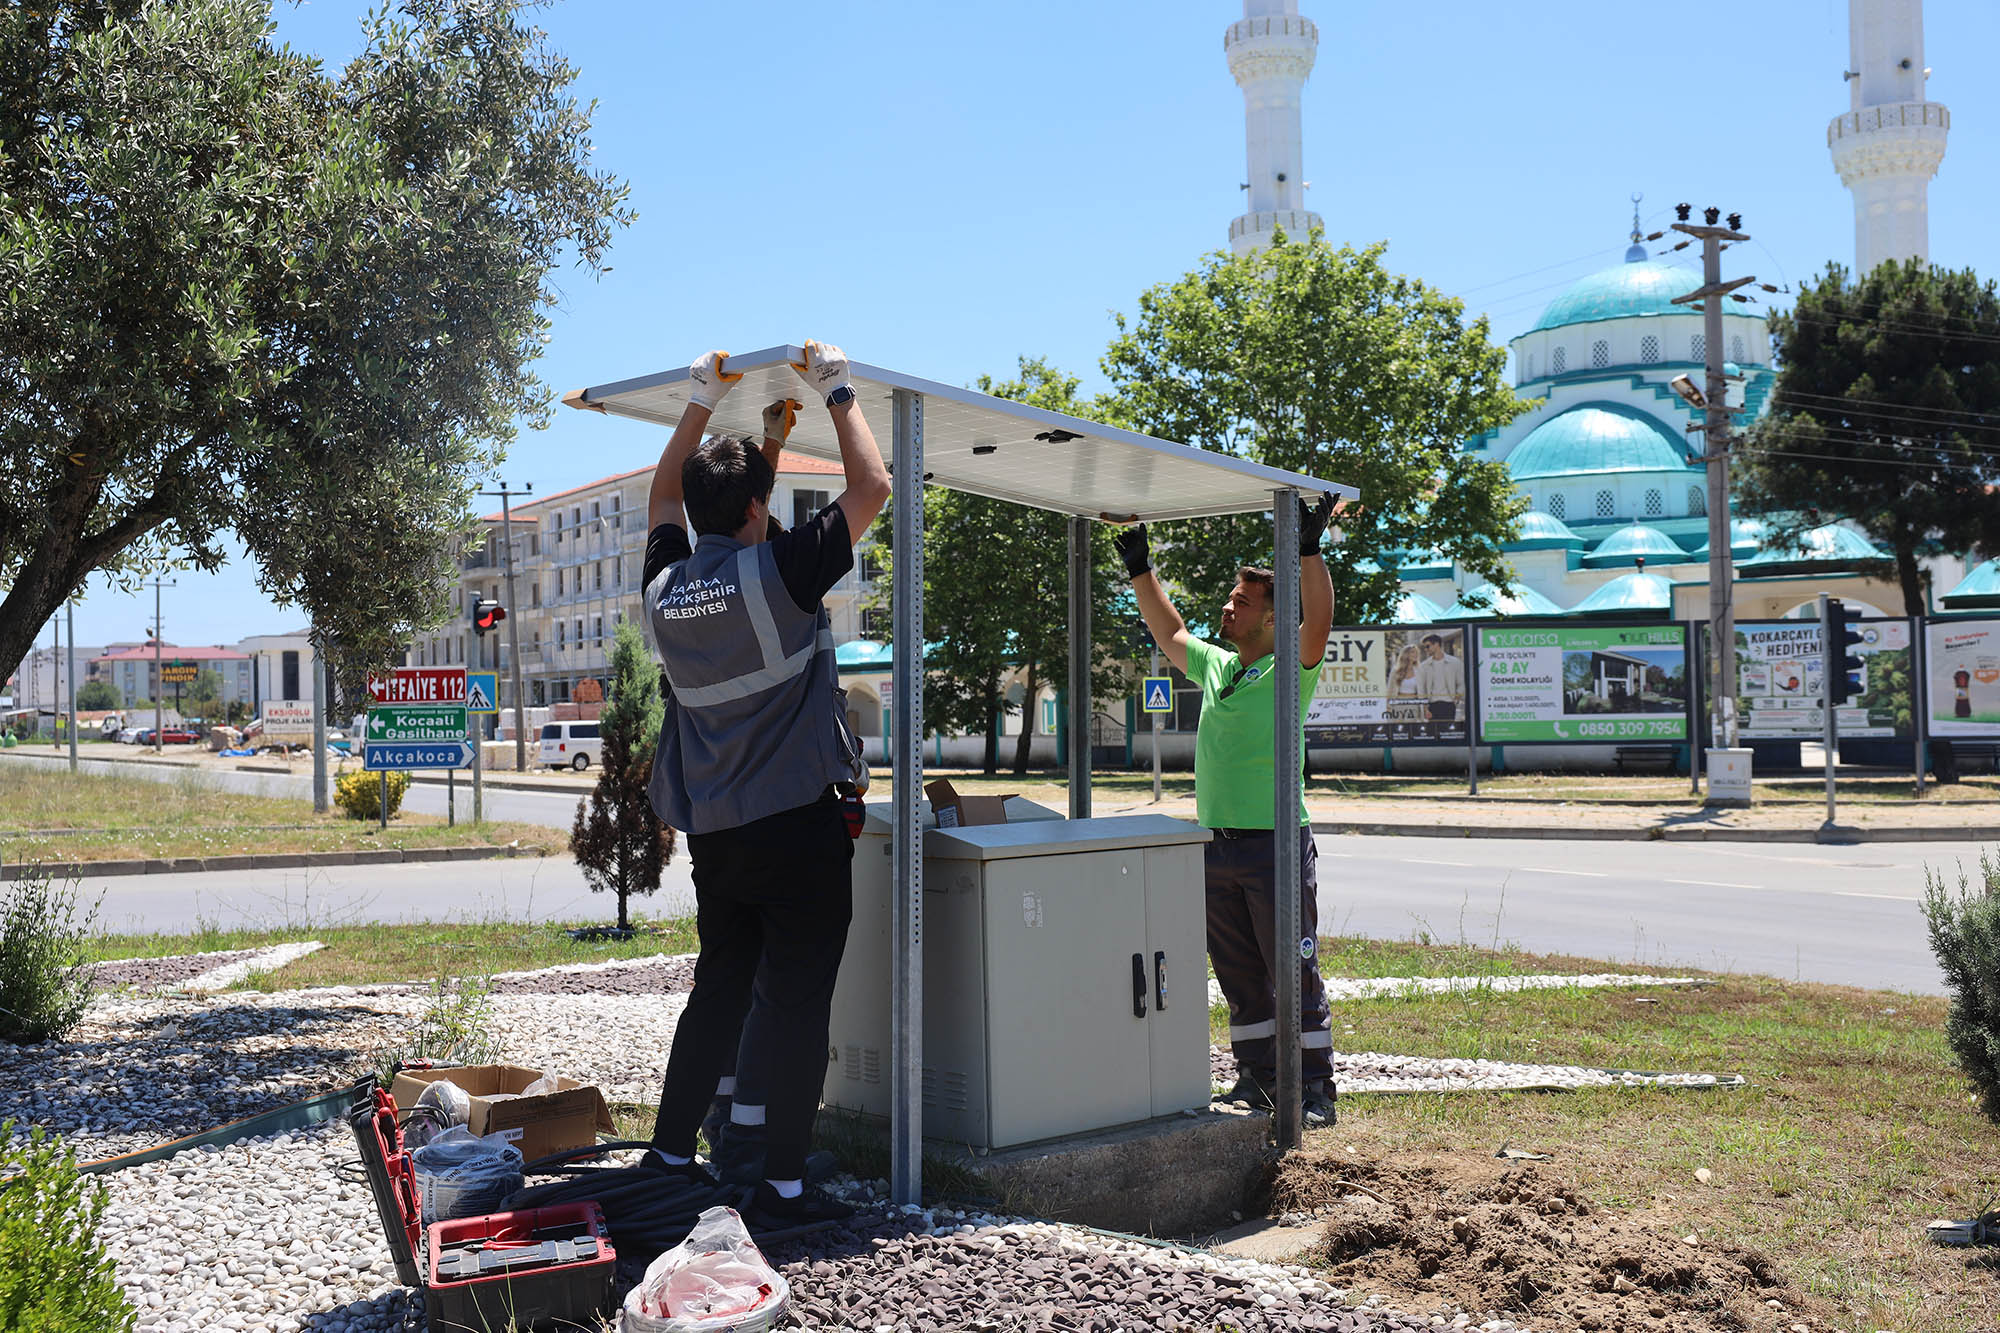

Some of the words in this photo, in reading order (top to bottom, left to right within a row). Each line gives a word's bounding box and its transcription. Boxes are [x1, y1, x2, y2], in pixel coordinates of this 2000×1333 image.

[663, 598, 728, 619] BELEDİYESİ
[1751, 629, 1813, 644] KOKARCAYI
[1490, 661, 1507, 674] 48
[1511, 661, 1529, 674] AY
[442, 677, 464, 699] 112
[1325, 684, 1379, 694] ÜRÜNLER
[396, 714, 455, 727] Kocaali
[386, 727, 465, 739] Gasilhane
[1579, 722, 1615, 736] 0850
[1618, 722, 1645, 735] 309
[1648, 721, 1681, 735] 7954
[371, 750, 456, 765] Akçakoca
